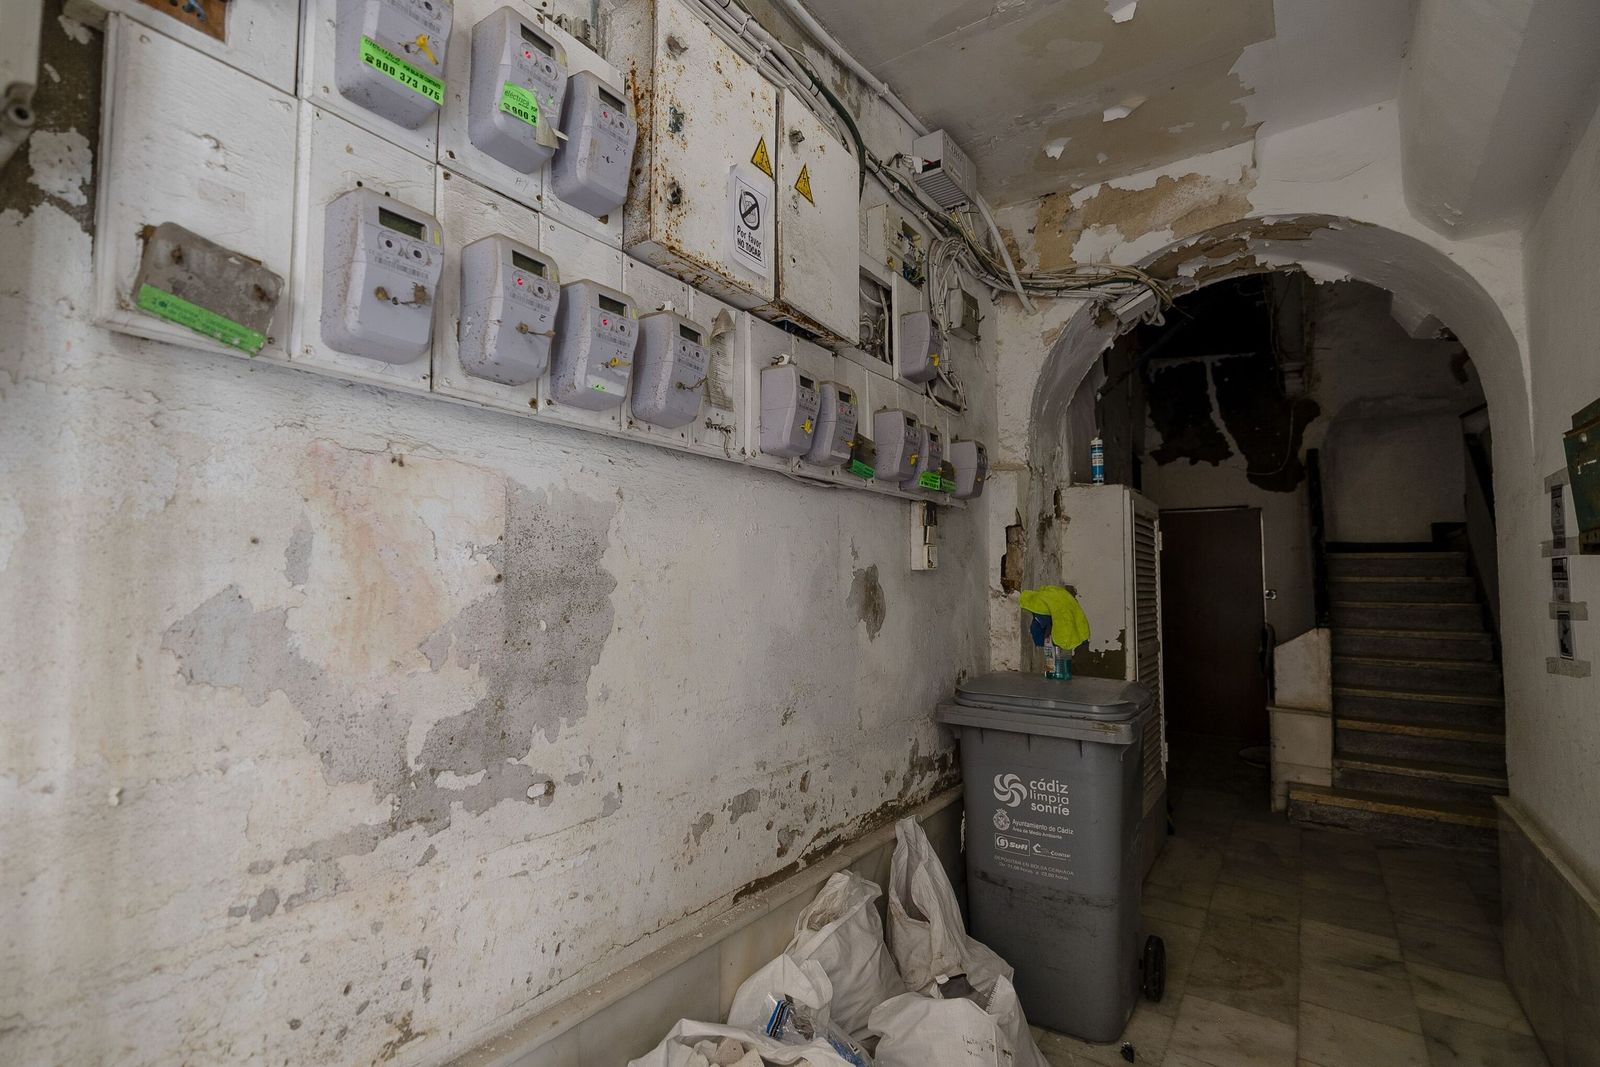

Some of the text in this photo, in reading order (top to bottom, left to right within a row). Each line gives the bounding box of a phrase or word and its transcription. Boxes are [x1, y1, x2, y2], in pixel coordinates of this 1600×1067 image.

[400, 72, 418, 89] 373
[422, 85, 440, 100] 075
[737, 225, 762, 248] Por favor
[737, 234, 745, 248] NO
[1030, 778, 1069, 794] cádiz
[1030, 789, 1069, 805] limpia
[1030, 802, 1070, 816] sonríe
[1012, 819, 1048, 831] Ayuntamiento
[1056, 826, 1074, 835] Cádiz
